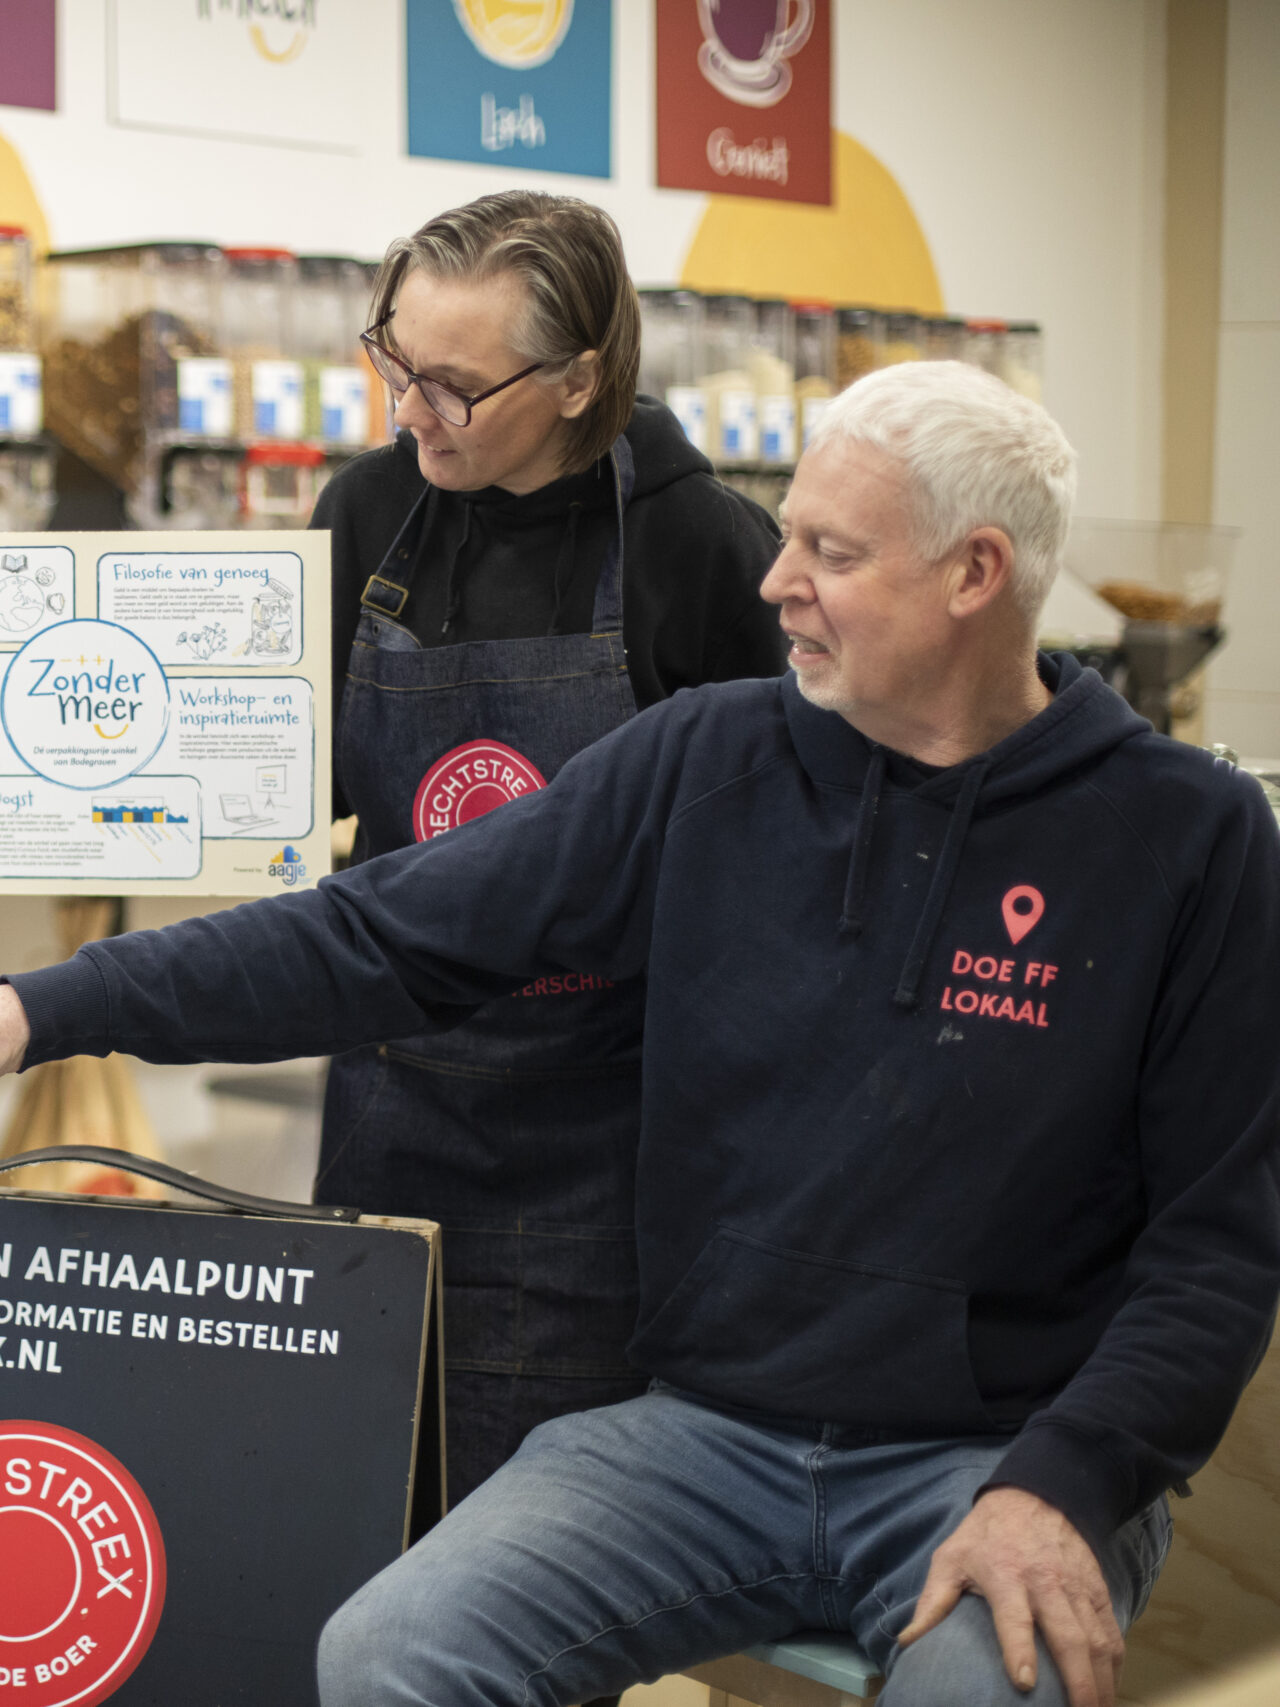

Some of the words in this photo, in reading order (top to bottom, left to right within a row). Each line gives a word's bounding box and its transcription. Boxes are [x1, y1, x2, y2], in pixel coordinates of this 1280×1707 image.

[113, 563, 173, 580] Filosofie
[179, 567, 208, 579] van
[214, 566, 270, 587] genoeg
[27, 658, 146, 697] Zonder
[179, 686, 267, 713] Workshop-
[273, 695, 293, 706] en
[179, 708, 300, 732] inspiratieruimte
[267, 863, 307, 887] aagje
[952, 950, 1016, 982] DOE
[1024, 962, 1059, 988] FF
[940, 986, 1049, 1028] LOKAAL
[24, 1246, 314, 1305] AFHAALPUNT
[131, 1312, 168, 1340] EN
[178, 1317, 339, 1355] BESTELLEN
[34, 1634, 98, 1684] BOER
